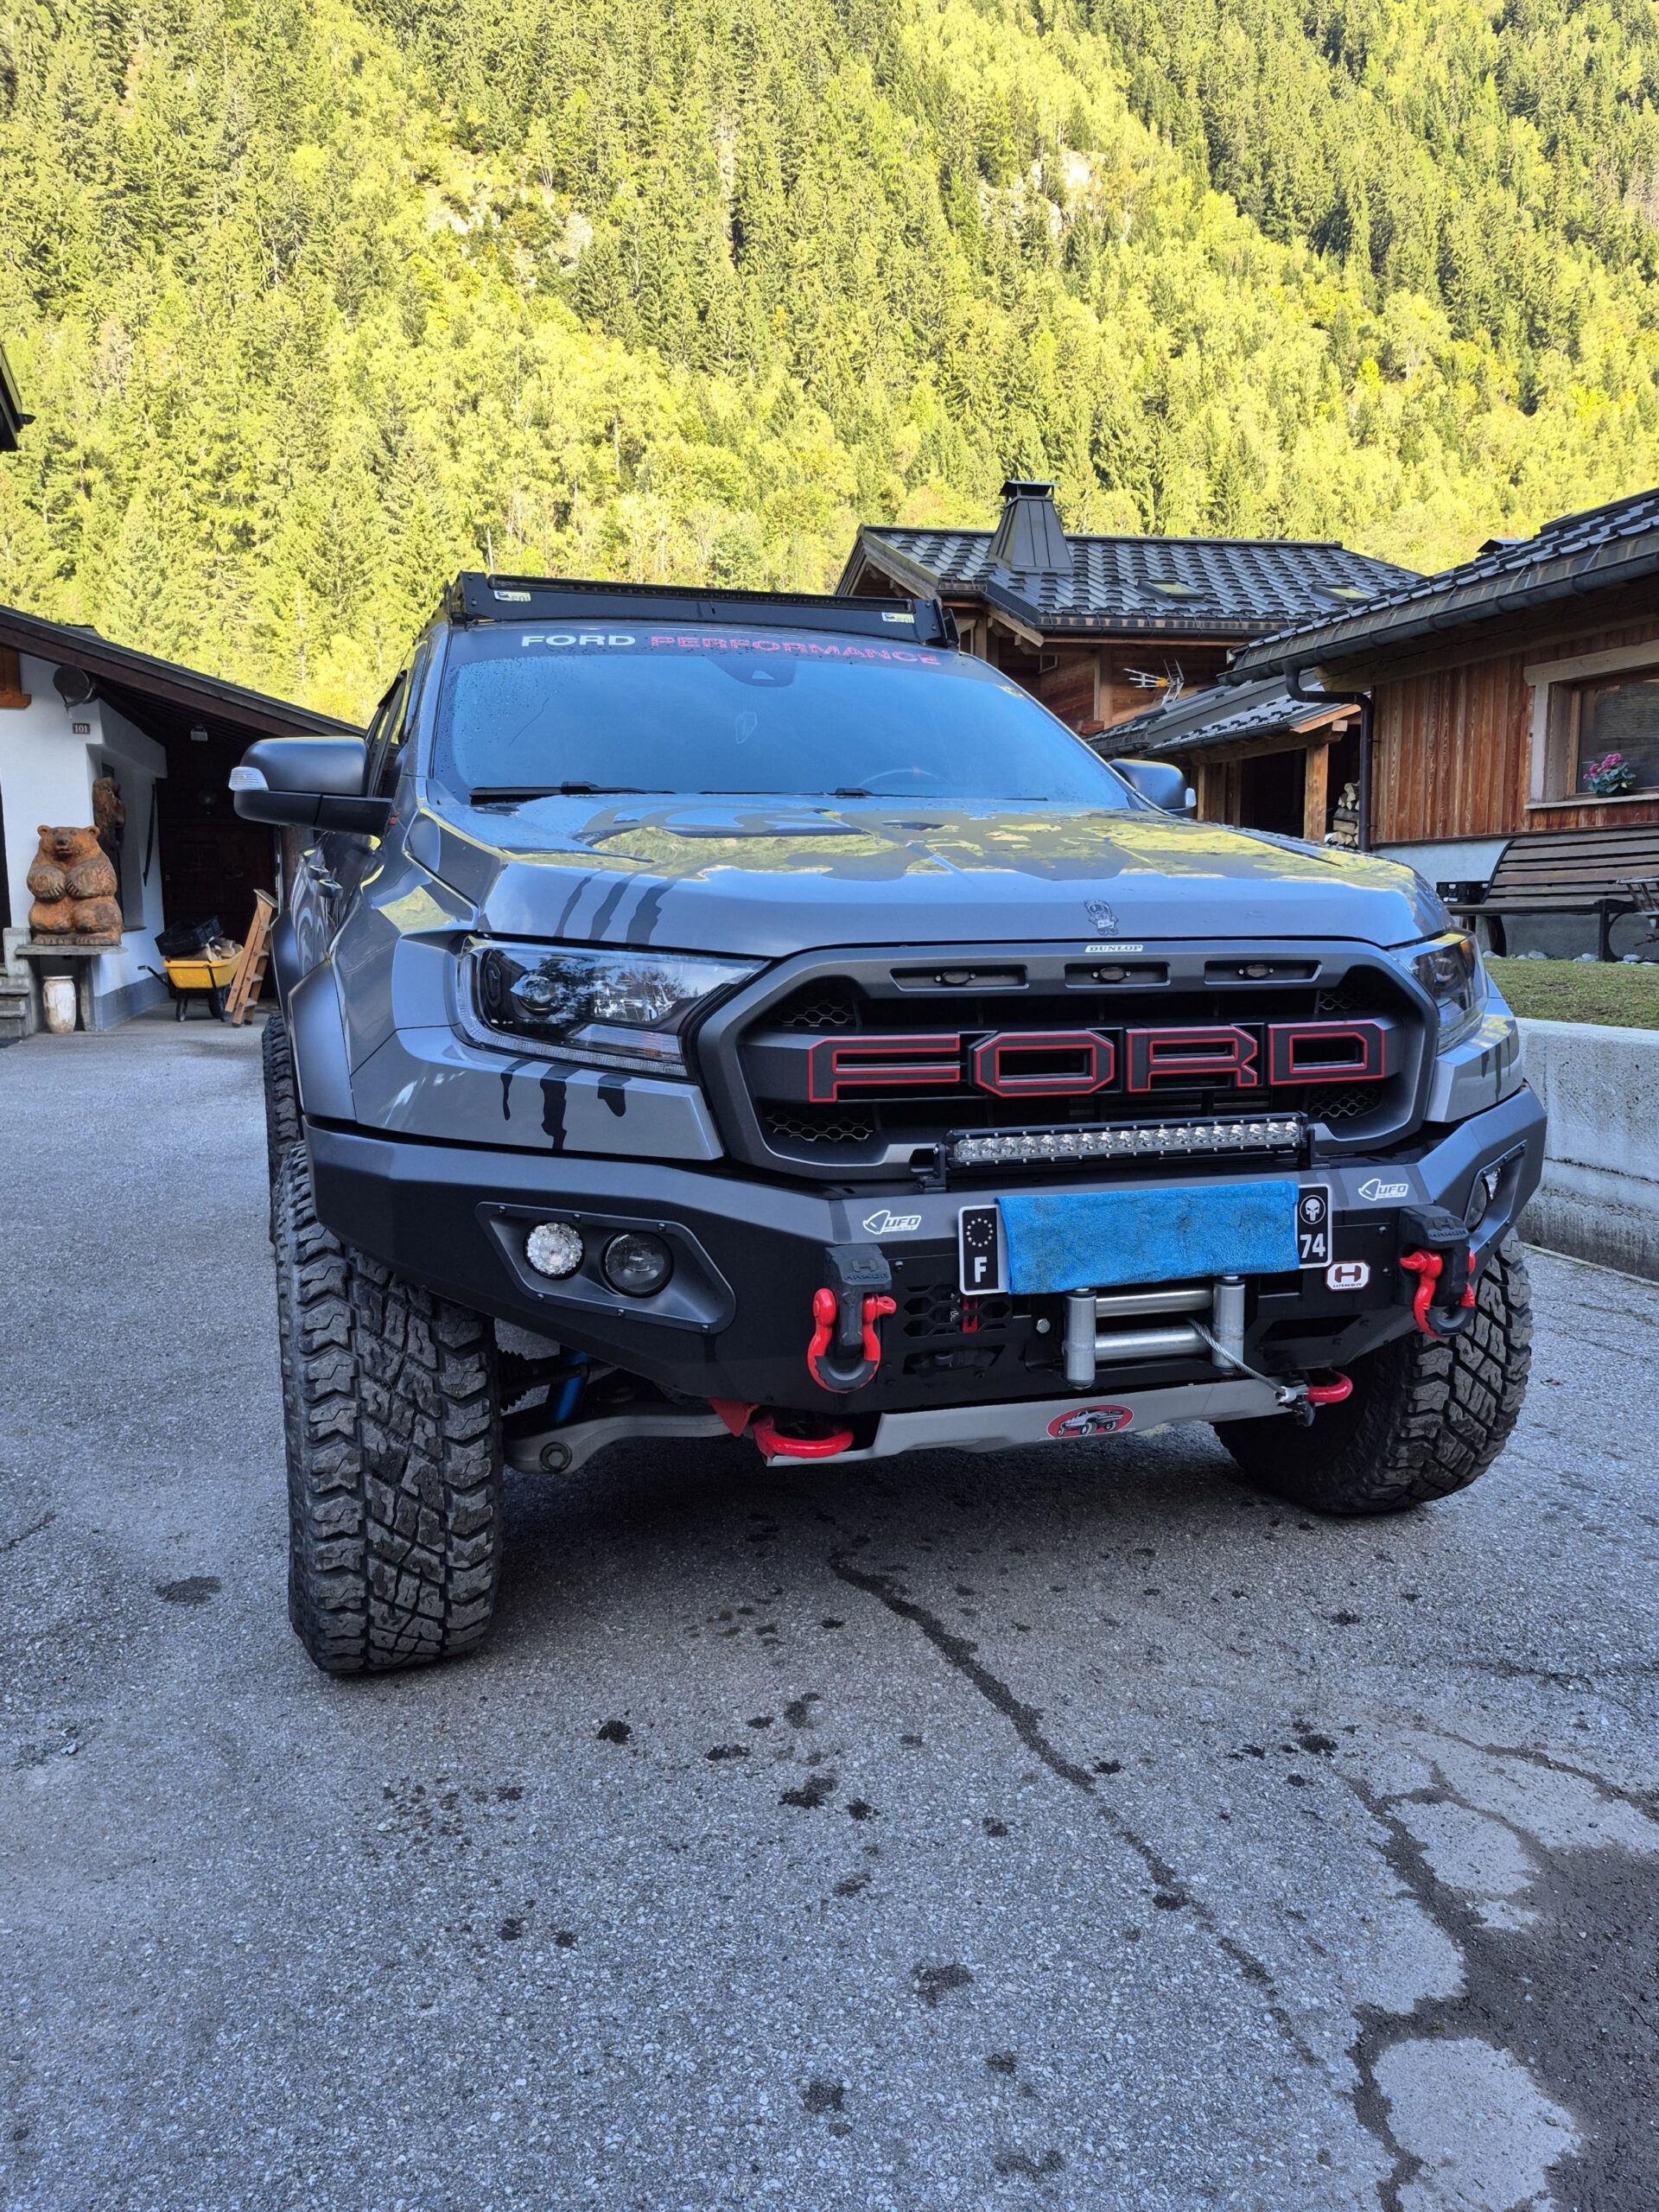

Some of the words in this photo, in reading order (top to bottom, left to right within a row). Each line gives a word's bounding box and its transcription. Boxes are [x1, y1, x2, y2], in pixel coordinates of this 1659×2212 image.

[521, 634, 636, 647] FORD
[651, 635, 941, 665] PERFORMANCE
[73, 724, 88, 734] 101
[807, 1020, 1385, 1103] FORD
[1377, 1185, 1408, 1194] UFO
[885, 1217, 920, 1227] UFO
[1299, 1232, 1326, 1259] 74
[974, 1256, 988, 1282] F
